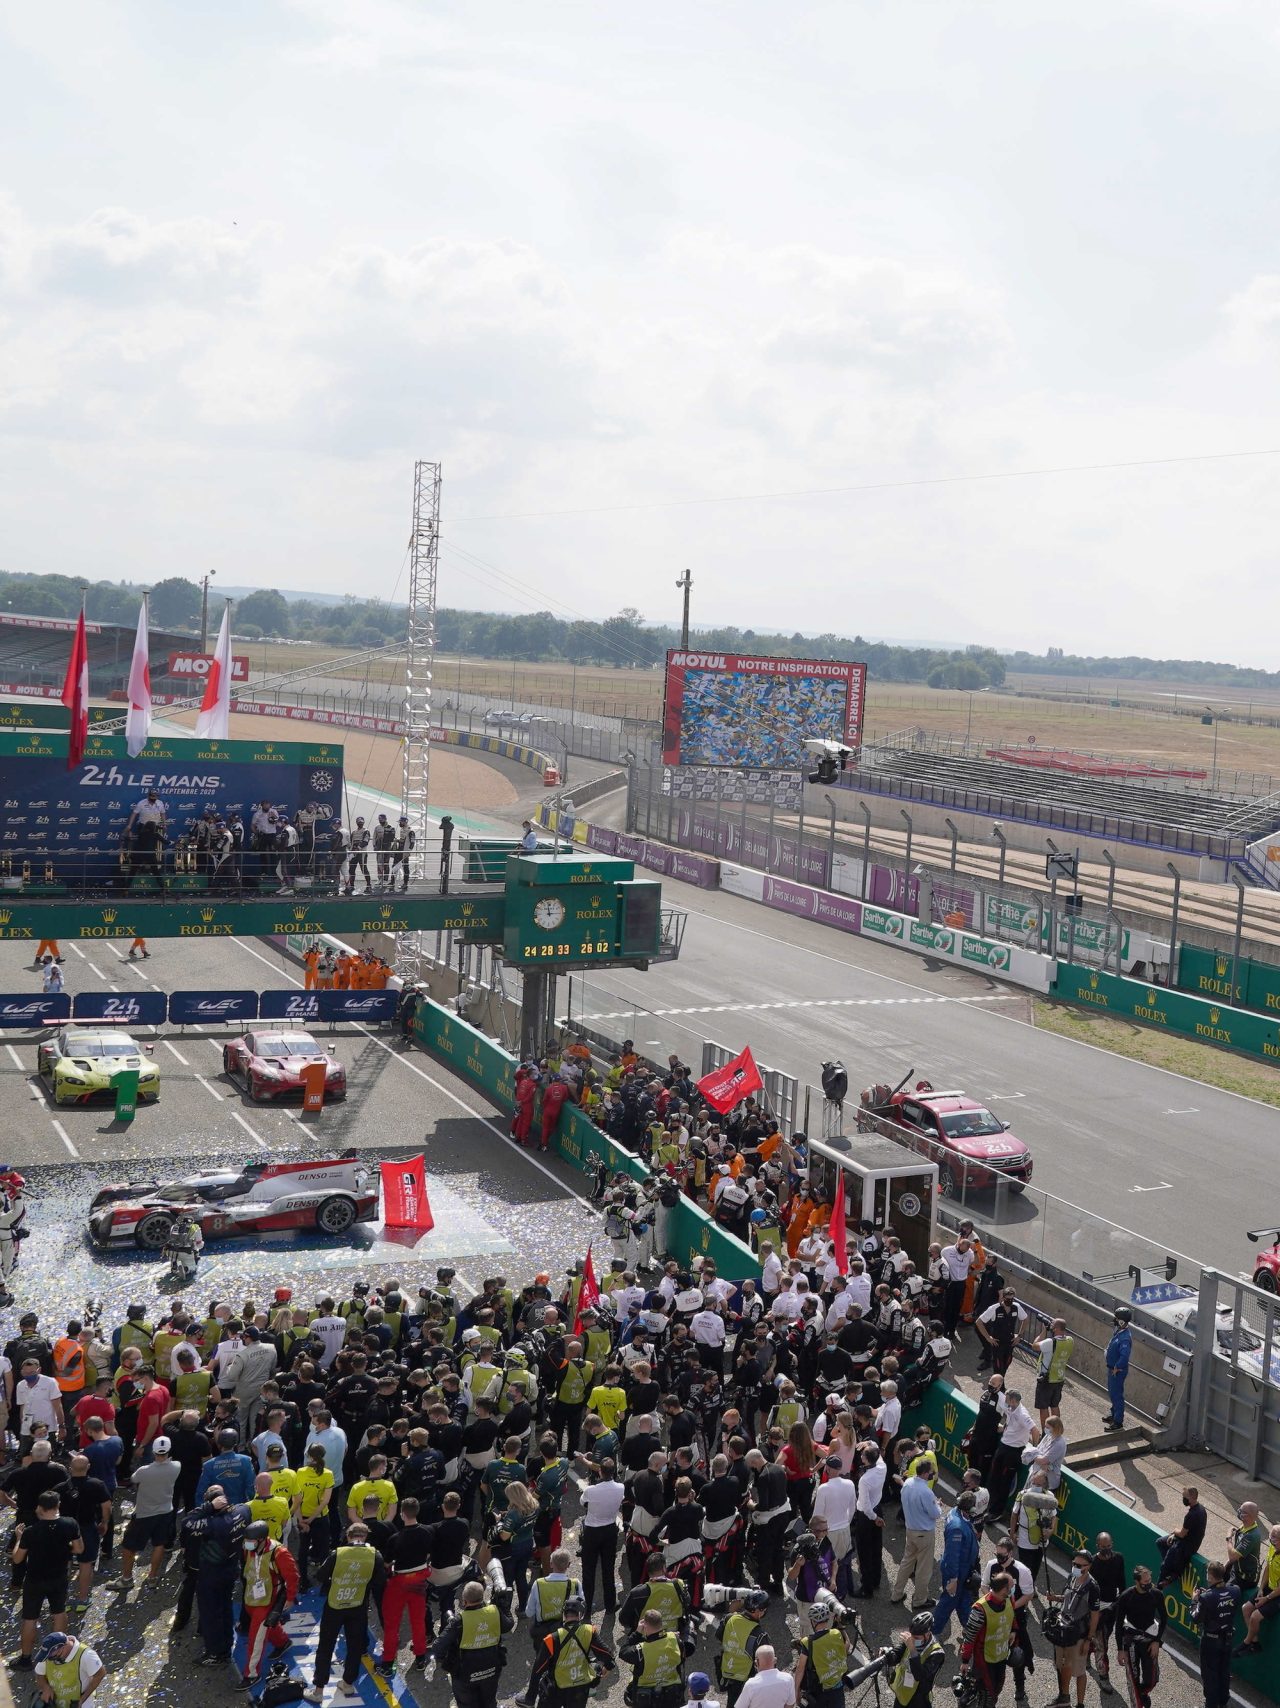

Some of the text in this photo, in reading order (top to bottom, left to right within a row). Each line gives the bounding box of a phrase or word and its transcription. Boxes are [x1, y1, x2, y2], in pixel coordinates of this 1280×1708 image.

[173, 658, 244, 676] MOL
[671, 654, 848, 676] MOTUL NOTRE INSPIRATION
[16, 686, 44, 696] MOTUL
[237, 703, 260, 713] MOTUL
[265, 705, 287, 716] MOTUL
[291, 709, 309, 720] MOTUL
[198, 752, 230, 760] ROLEX
[308, 756, 338, 764] ROLEX
[80, 765, 220, 787] 24h LE MANS
[783, 852, 793, 865] PAYS
[809, 860, 822, 873] LOIRE
[571, 875, 602, 883] ROLEX
[775, 888, 785, 899] PAYS
[784, 891, 789, 900] DE
[795, 895, 807, 907] LOIRE
[900, 887, 916, 901] PYS
[576, 910, 613, 919] ROLEX
[820, 904, 855, 922] PAYS DE LA LOIRE
[865, 911, 884, 924] Sarthe
[0, 918, 488, 937] LEX ROLEX ROLEX ROLEX ROLEX ROLEX
[912, 925, 934, 939] Sarthe
[1063, 922, 1095, 939] Srthe
[525, 943, 608, 957] 24 28 33 26 02
[964, 938, 987, 955] Sarthe
[1199, 975, 1241, 999] ROLEX
[3, 1002, 53, 1013] WEC
[104, 999, 140, 1015] 24h
[198, 1000, 243, 1009] WEC
[287, 996, 319, 1011] 24h
[345, 998, 386, 1007] WEC
[1078, 988, 1108, 1007] ROLEX
[1134, 1004, 1167, 1024] ROLEX
[1196, 1023, 1231, 1043] ROLEX
[308, 1095, 321, 1104] AM
[437, 1035, 453, 1054] ROLEX
[467, 1056, 483, 1076] ROLEX
[561, 1135, 581, 1160] ROLEX
[120, 1104, 133, 1112] PRO
[267, 1166, 277, 1174] HY
[298, 1172, 328, 1181] DENSO
[403, 1173, 412, 1195] GR
[285, 1199, 319, 1209] DENSO
[213, 1219, 222, 1229] 8
[932, 1432, 970, 1471] OLEX
[1054, 1517, 1089, 1553] LEX
[336, 1588, 357, 1600] 592
